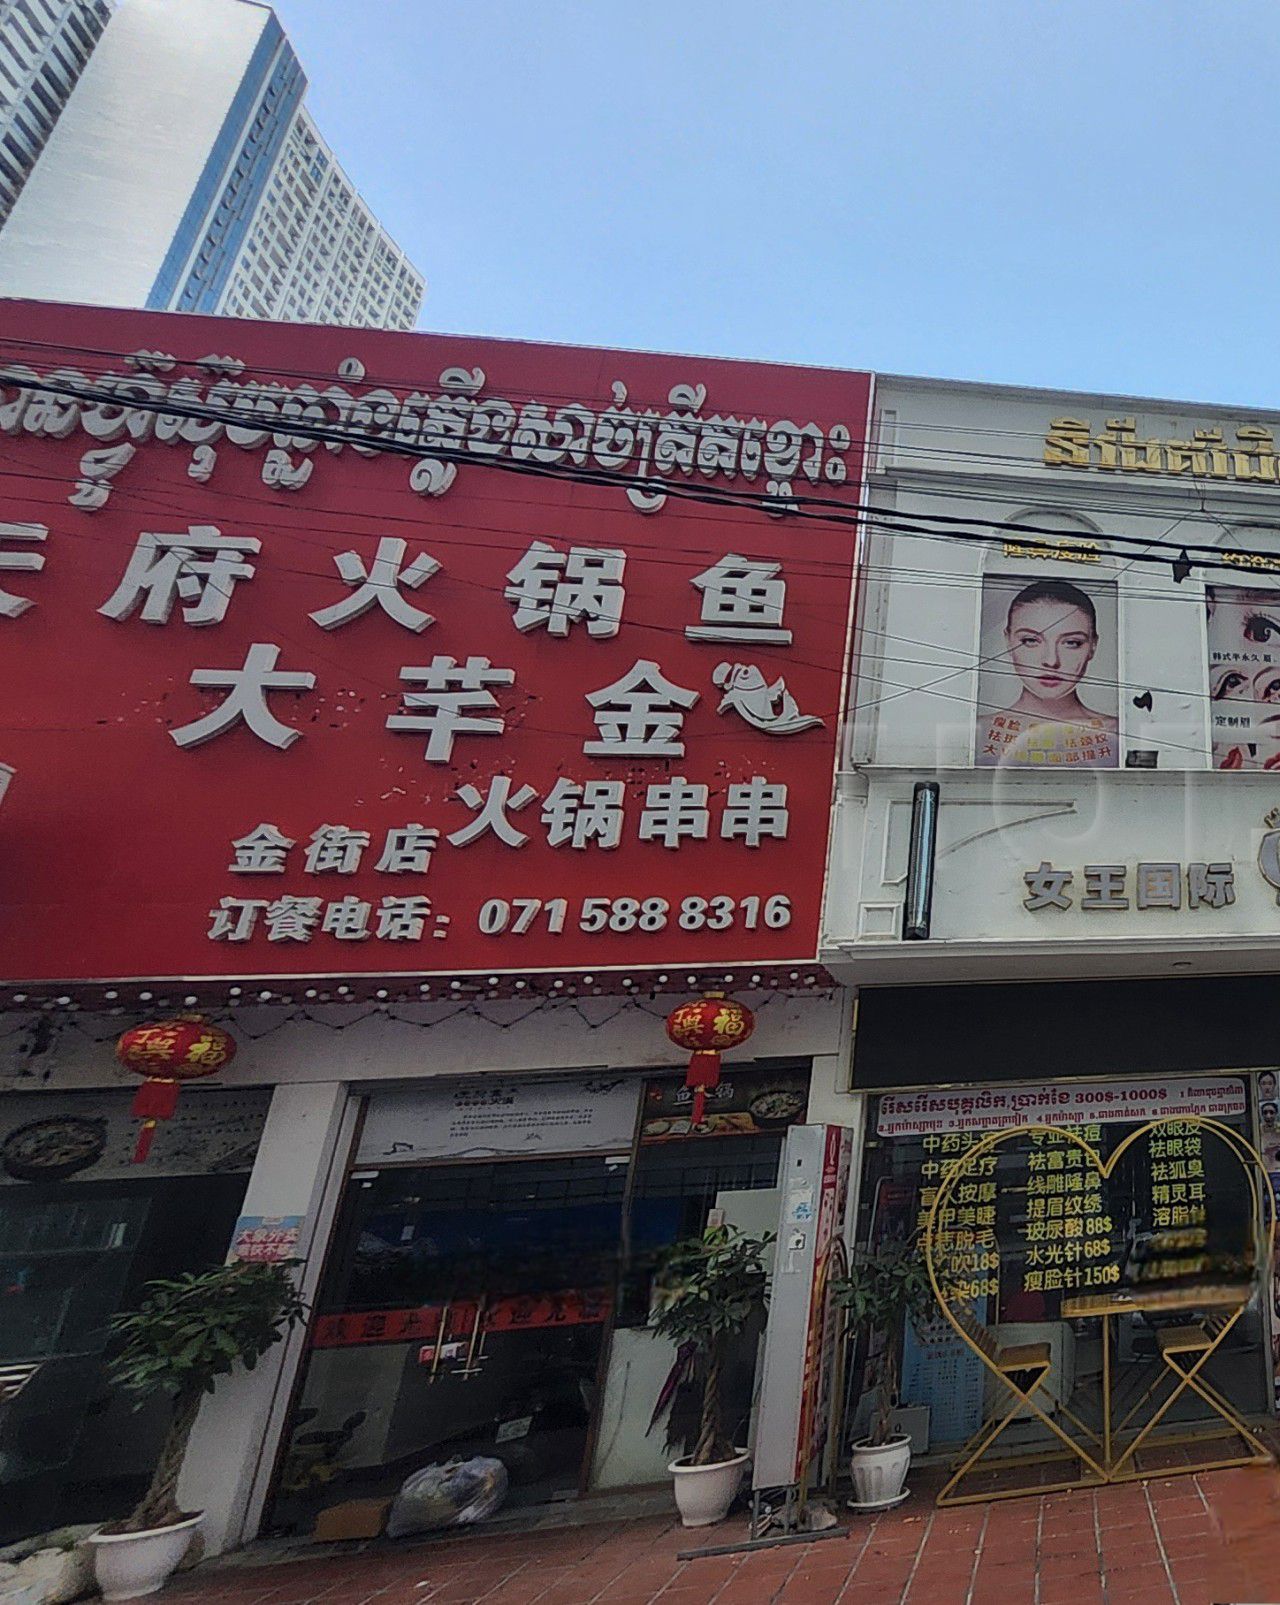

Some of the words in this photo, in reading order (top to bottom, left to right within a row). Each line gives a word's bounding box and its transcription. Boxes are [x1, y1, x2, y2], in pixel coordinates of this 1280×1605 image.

[447, 775, 789, 850] 火锅串串
[227, 822, 440, 876] 金街店
[1022, 861, 1237, 911] 女王国际
[207, 894, 451, 943] 订餐电话：
[477, 897, 564, 934] 071
[578, 895, 669, 934] 588
[677, 892, 792, 931] 8316
[673, 1081, 736, 1107] 鱼锅
[1075, 1087, 1168, 1105] 300$-1000$
[1148, 1137, 1203, 1159] 祛眼袋
[1026, 1171, 1102, 1196] 线雕隆鼻
[1150, 1159, 1206, 1183] 祛狐臭
[1026, 1194, 1103, 1220] 提眉纹绣
[1151, 1182, 1207, 1206] 精灵耳
